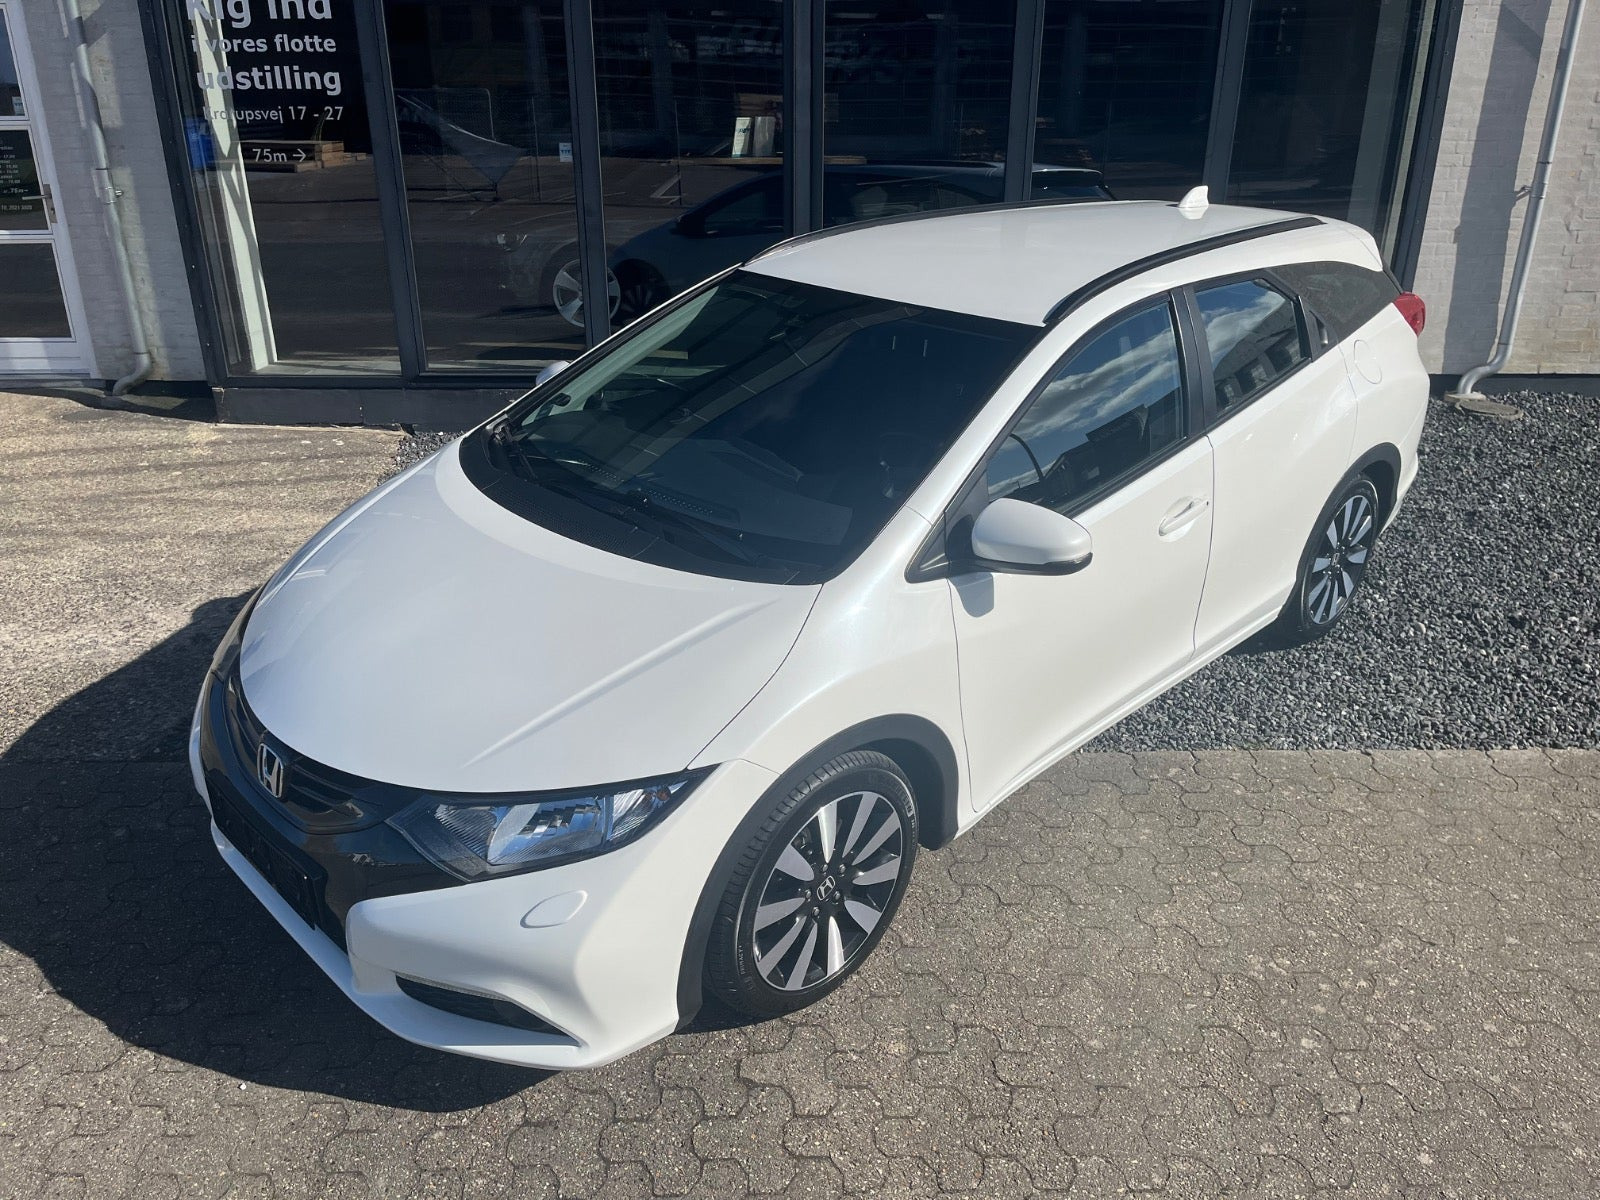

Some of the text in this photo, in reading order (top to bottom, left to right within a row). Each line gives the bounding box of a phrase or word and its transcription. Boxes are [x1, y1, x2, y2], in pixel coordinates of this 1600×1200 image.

[186, 0, 332, 28] Kig ind
[191, 34, 336, 52] i vores flotte
[197, 65, 342, 96] udstilling
[289, 106, 307, 120] 17
[324, 106, 344, 121] 27
[252, 148, 287, 162] 75m
